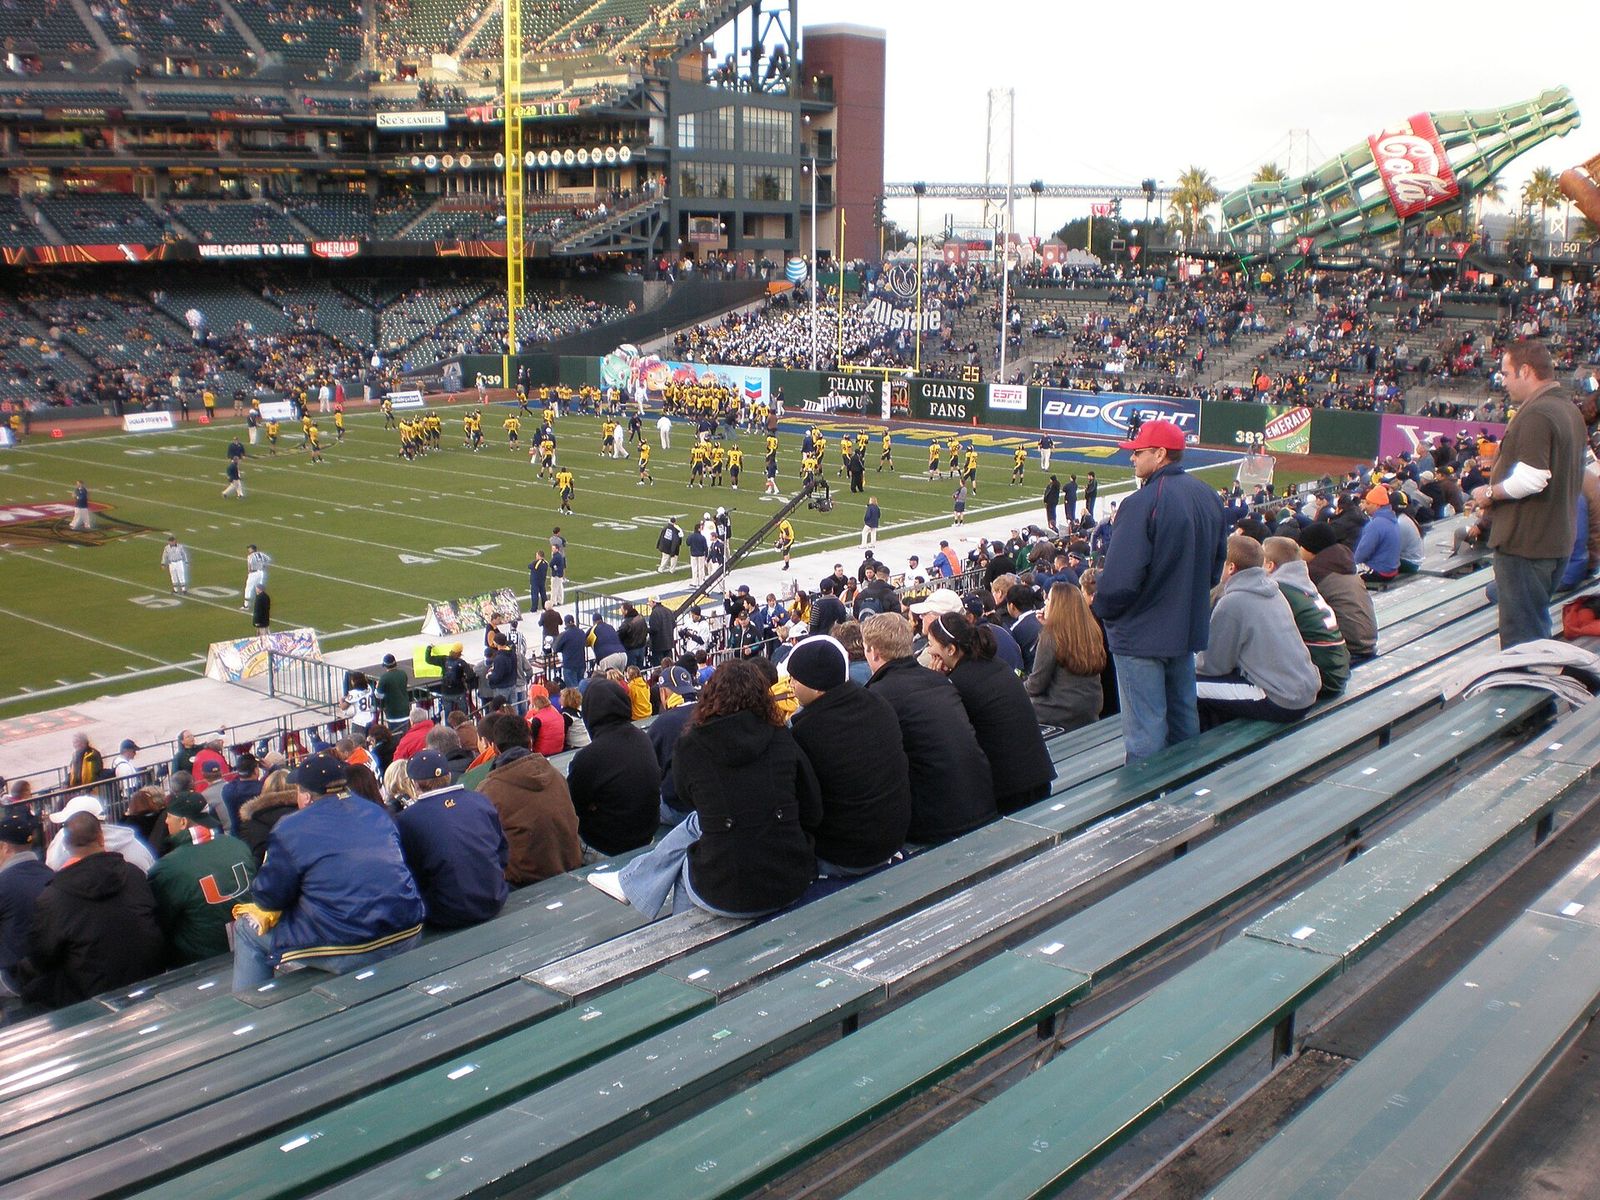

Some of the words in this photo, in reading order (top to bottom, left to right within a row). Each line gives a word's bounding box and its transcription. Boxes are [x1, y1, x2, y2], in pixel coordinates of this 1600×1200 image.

[198, 244, 260, 257] WELCOME
[261, 244, 279, 255] TO
[281, 243, 305, 255] THE
[315, 241, 355, 253] EMERALD
[1563, 242, 1580, 253] 501
[862, 297, 941, 331] Allstate
[962, 365, 980, 382] 25
[828, 376, 875, 393] THANK
[922, 383, 975, 401] GIANTS
[929, 402, 967, 418] FANS
[1044, 400, 1101, 418] BUD
[1113, 406, 1196, 426] LGHT
[1265, 407, 1311, 438] EMERALD
[198, 861, 250, 905] U
